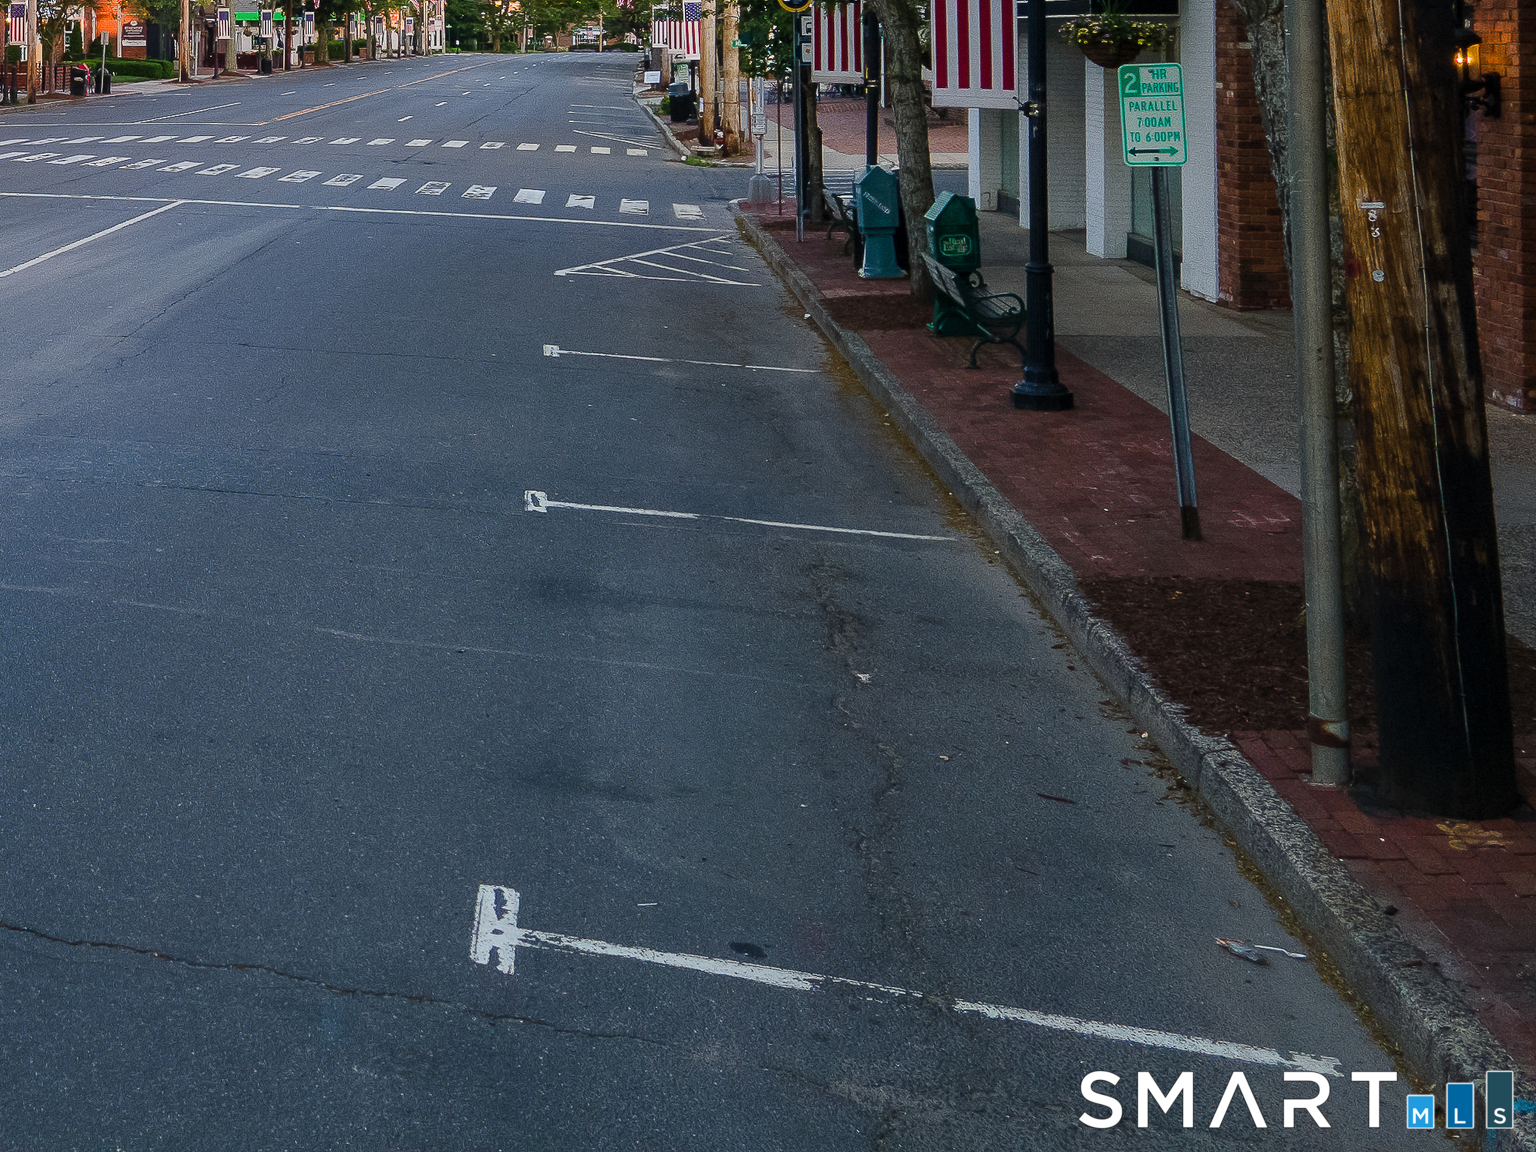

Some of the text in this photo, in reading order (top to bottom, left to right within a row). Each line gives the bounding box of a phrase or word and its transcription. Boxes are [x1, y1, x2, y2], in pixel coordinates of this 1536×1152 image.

[1124, 69, 1167, 94] 2 HR
[1142, 81, 1179, 94] PARKING
[1129, 100, 1178, 112] PARALLEL
[1130, 131, 1141, 143] TO
